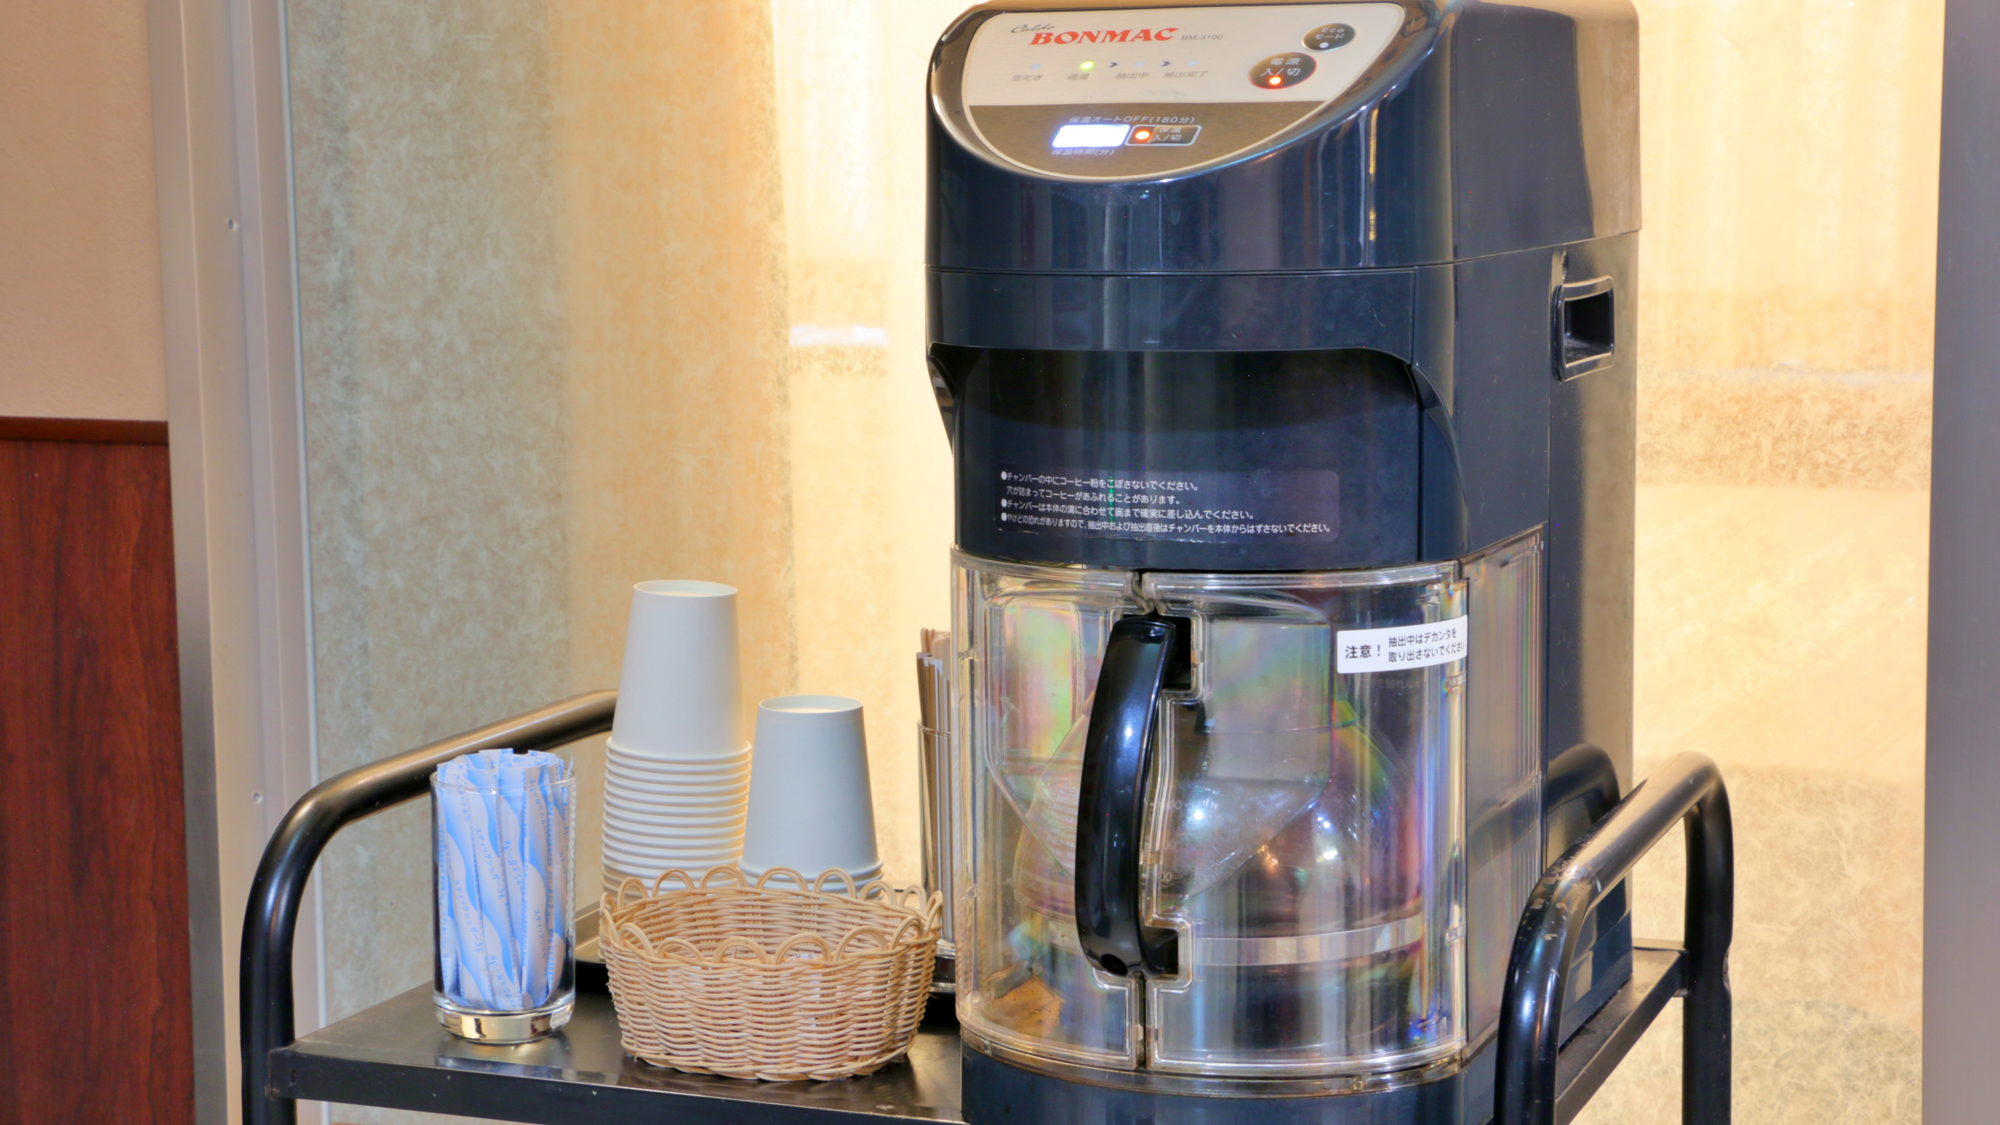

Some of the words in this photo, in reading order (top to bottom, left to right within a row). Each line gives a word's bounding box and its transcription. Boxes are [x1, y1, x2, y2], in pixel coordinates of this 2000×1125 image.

[1028, 27, 1180, 45] BONMAC
[1270, 57, 1301, 66] 電源
[1115, 71, 1149, 79] 抽出中
[1163, 70, 1208, 78] 抽出完了
[1007, 472, 1198, 491] チャンバーの中にコーヒー粉をこぼさないでください。
[1007, 486, 1180, 505] 穴が詰まってコーヒーがあふれることがあります。
[1388, 628, 1457, 648] 抽出中はデカンタを
